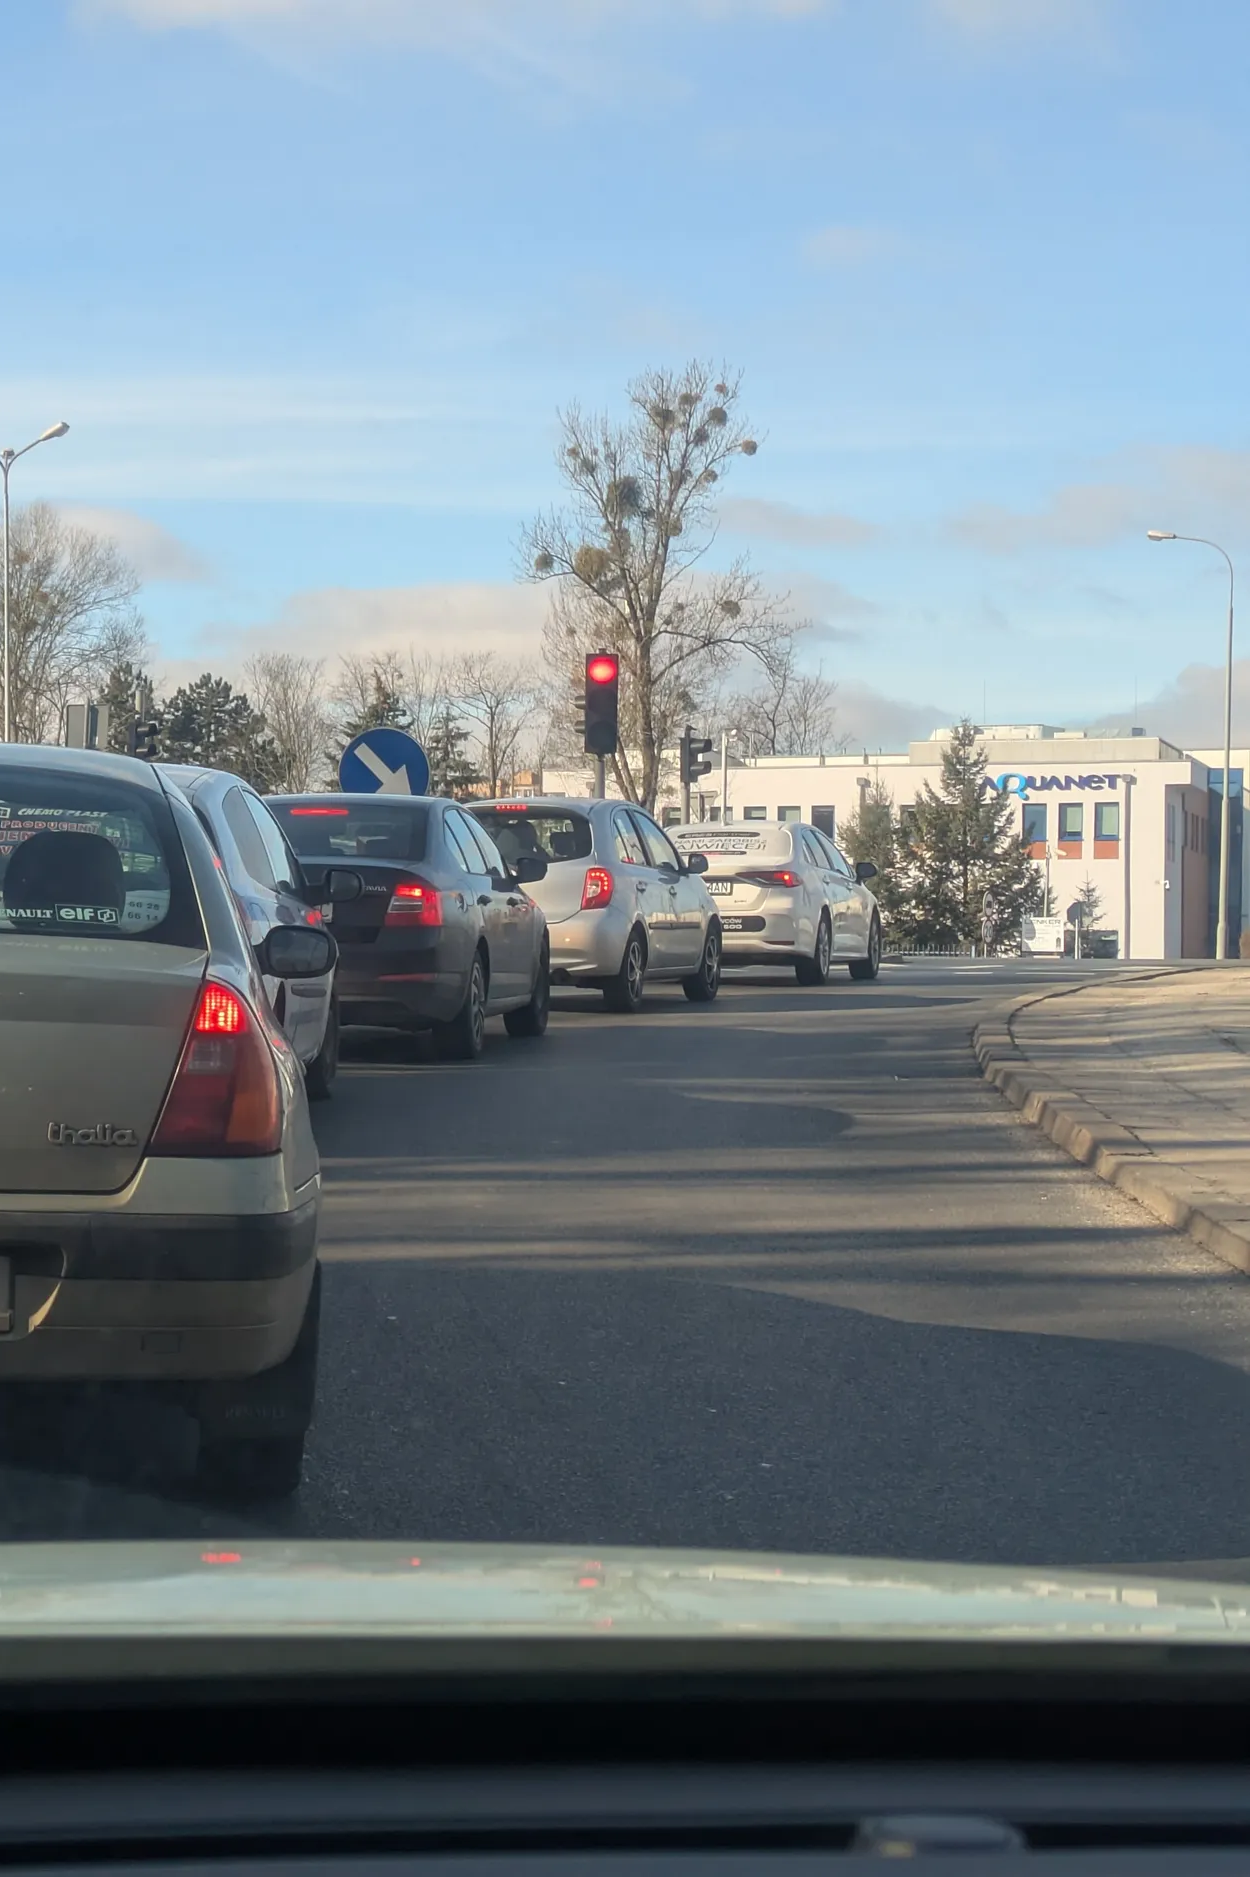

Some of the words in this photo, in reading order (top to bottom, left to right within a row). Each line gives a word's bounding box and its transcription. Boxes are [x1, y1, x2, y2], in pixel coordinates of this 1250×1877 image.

[0, 820, 100, 834] PRODUCENT
[59, 907, 95, 921] elf
[47, 1122, 139, 1146] thalia
